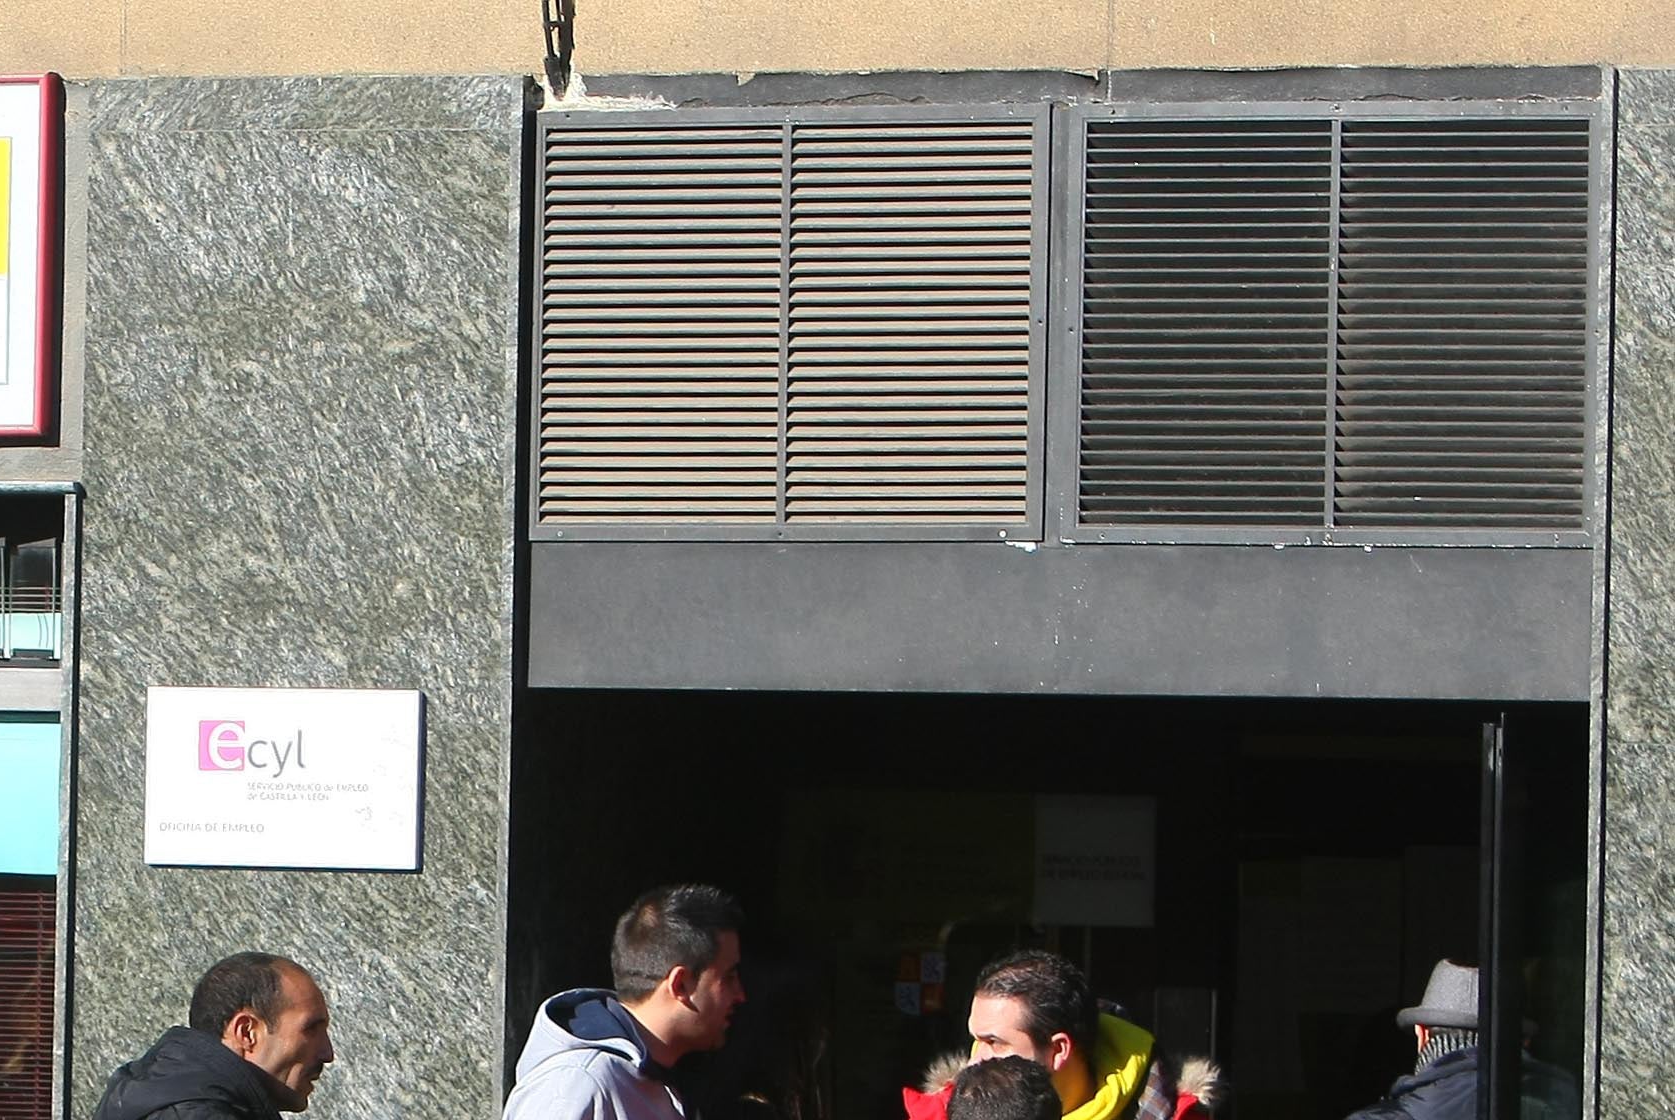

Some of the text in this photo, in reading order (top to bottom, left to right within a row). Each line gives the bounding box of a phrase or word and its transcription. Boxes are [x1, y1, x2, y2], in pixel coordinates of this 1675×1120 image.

[159, 822, 265, 834] OFICINA DE EMPLEO
